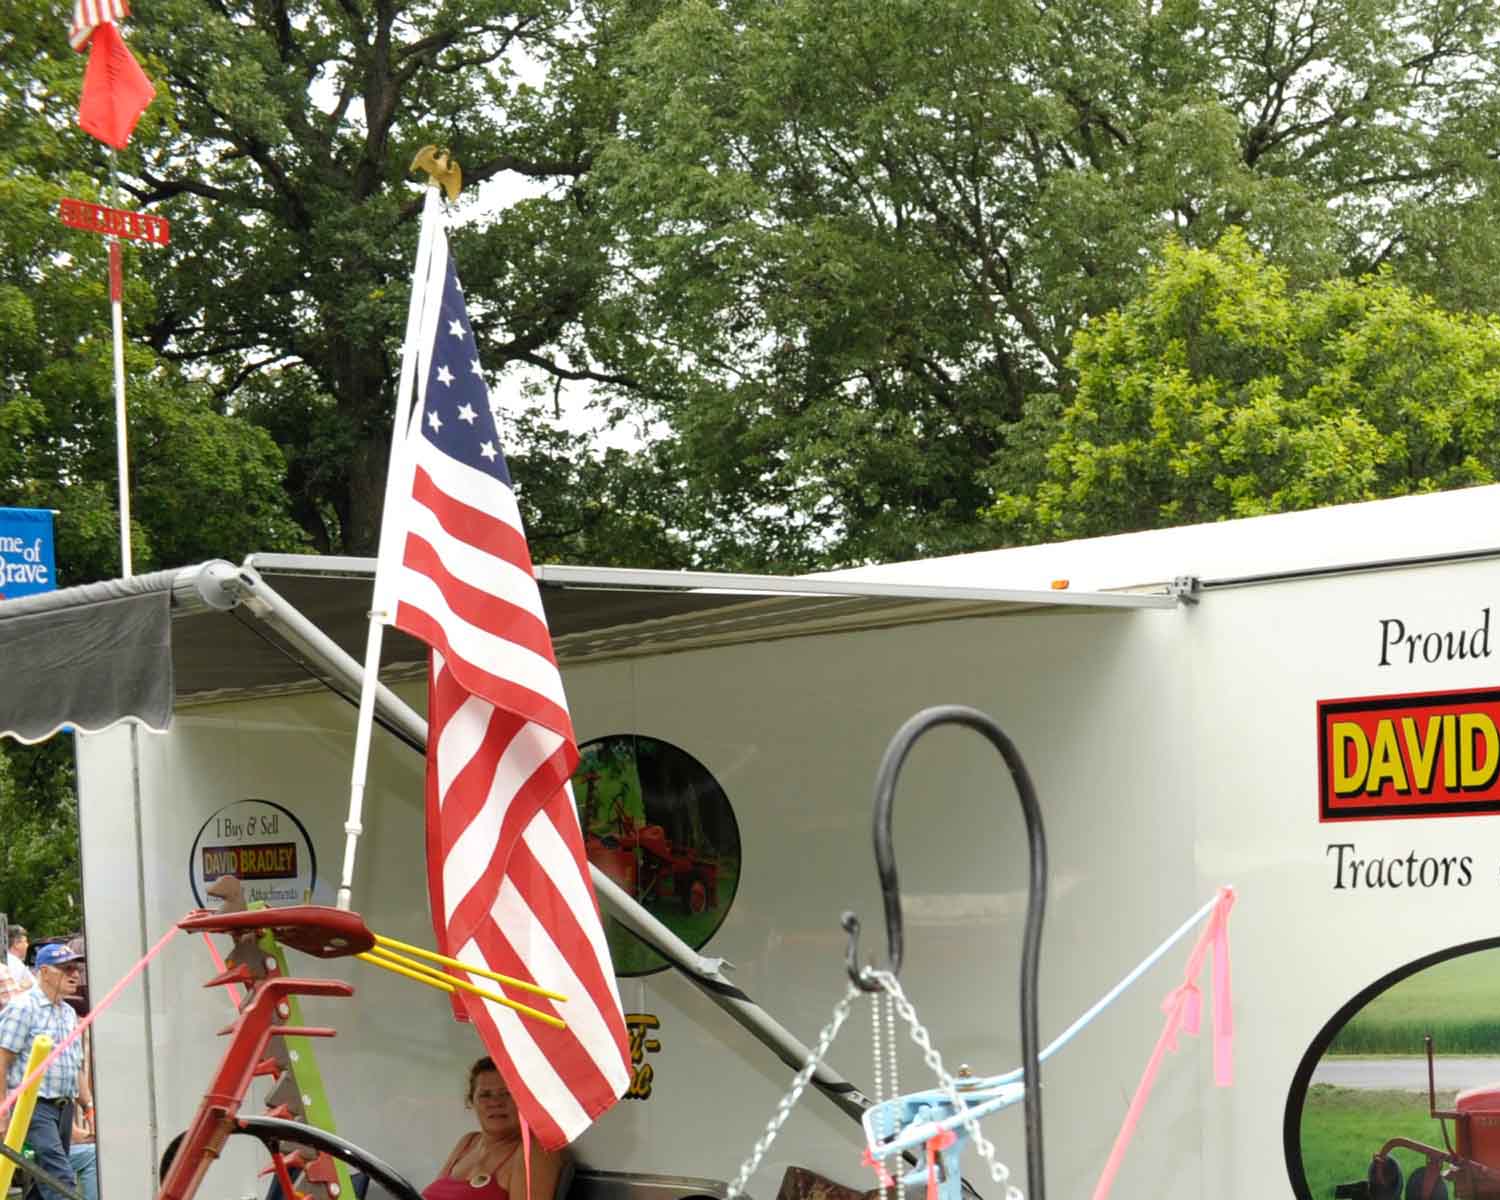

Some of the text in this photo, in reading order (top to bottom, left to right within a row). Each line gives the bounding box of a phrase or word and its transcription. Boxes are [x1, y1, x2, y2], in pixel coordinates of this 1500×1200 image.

[0, 536, 42, 562] me of
[1378, 608, 1492, 666] Proud
[1332, 712, 1500, 795] DAVID
[224, 817, 244, 840] Buy
[246, 815, 258, 837] &
[260, 814, 279, 836] Sell
[206, 846, 294, 875] DAVID BRADLEY
[1327, 842, 1473, 890] Tractors
